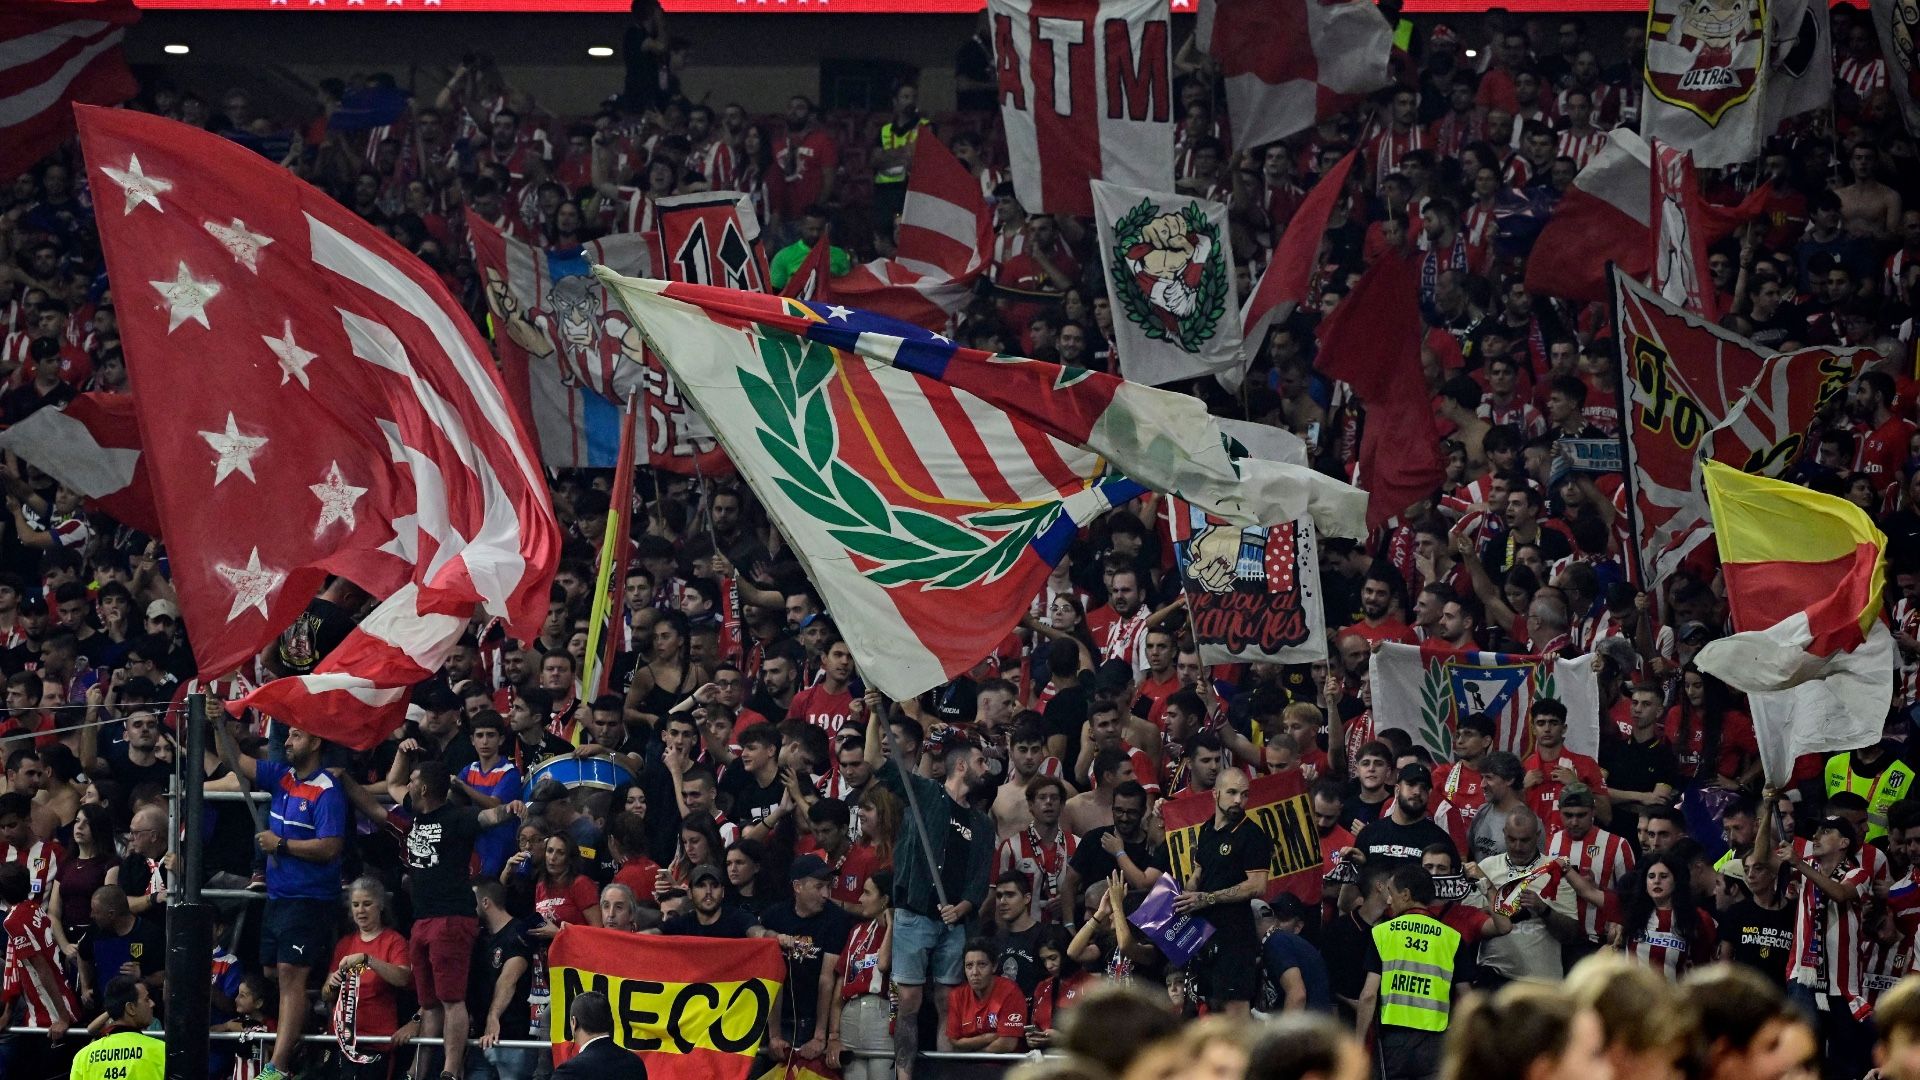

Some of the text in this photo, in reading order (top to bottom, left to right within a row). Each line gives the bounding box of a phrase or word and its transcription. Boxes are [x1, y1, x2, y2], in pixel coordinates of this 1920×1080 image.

[993, 12, 1169, 123] ATM
[1683, 68, 1733, 87] ULTRAS
[1390, 921, 1442, 937] SEGURIDAD
[1762, 928, 1777, 937] BAD
[1405, 936, 1429, 952] 343
[1741, 935, 1792, 950] DANGEROUS
[1391, 973, 1431, 996] ARIETE
[89, 1046, 143, 1064] SEGURIDAD
[103, 1066, 127, 1080] 484
